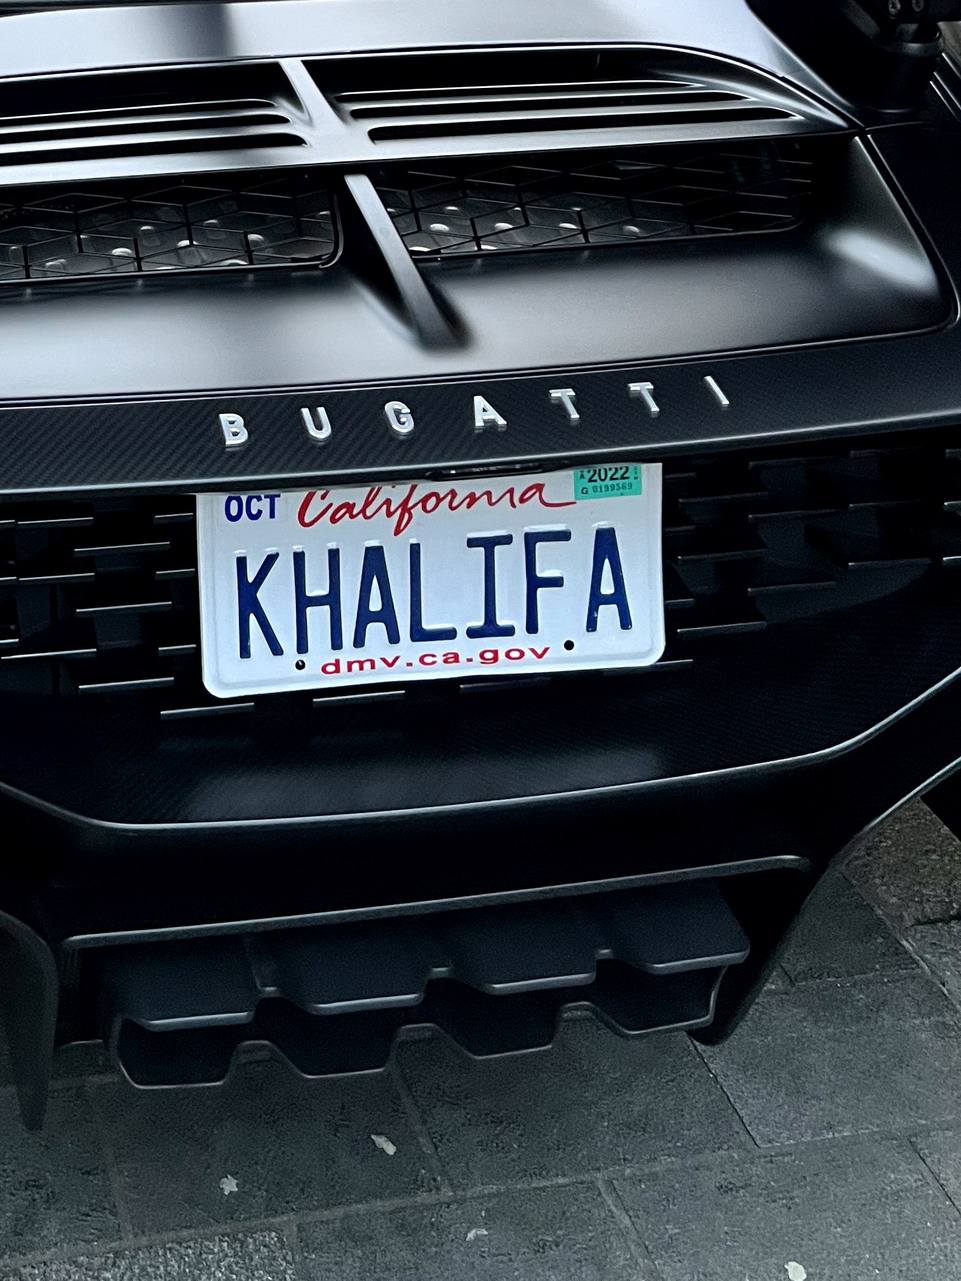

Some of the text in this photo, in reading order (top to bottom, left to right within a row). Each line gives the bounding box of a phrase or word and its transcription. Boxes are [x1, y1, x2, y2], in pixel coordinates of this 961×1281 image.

[218, 375, 730, 446] BUGATTI
[586, 466, 631, 483] 2022
[224, 493, 281, 523] OCT
[296, 481, 578, 537] California
[235, 522, 633, 659] KHALIFA
[320, 645, 551, 675] dmv.ca.gov
